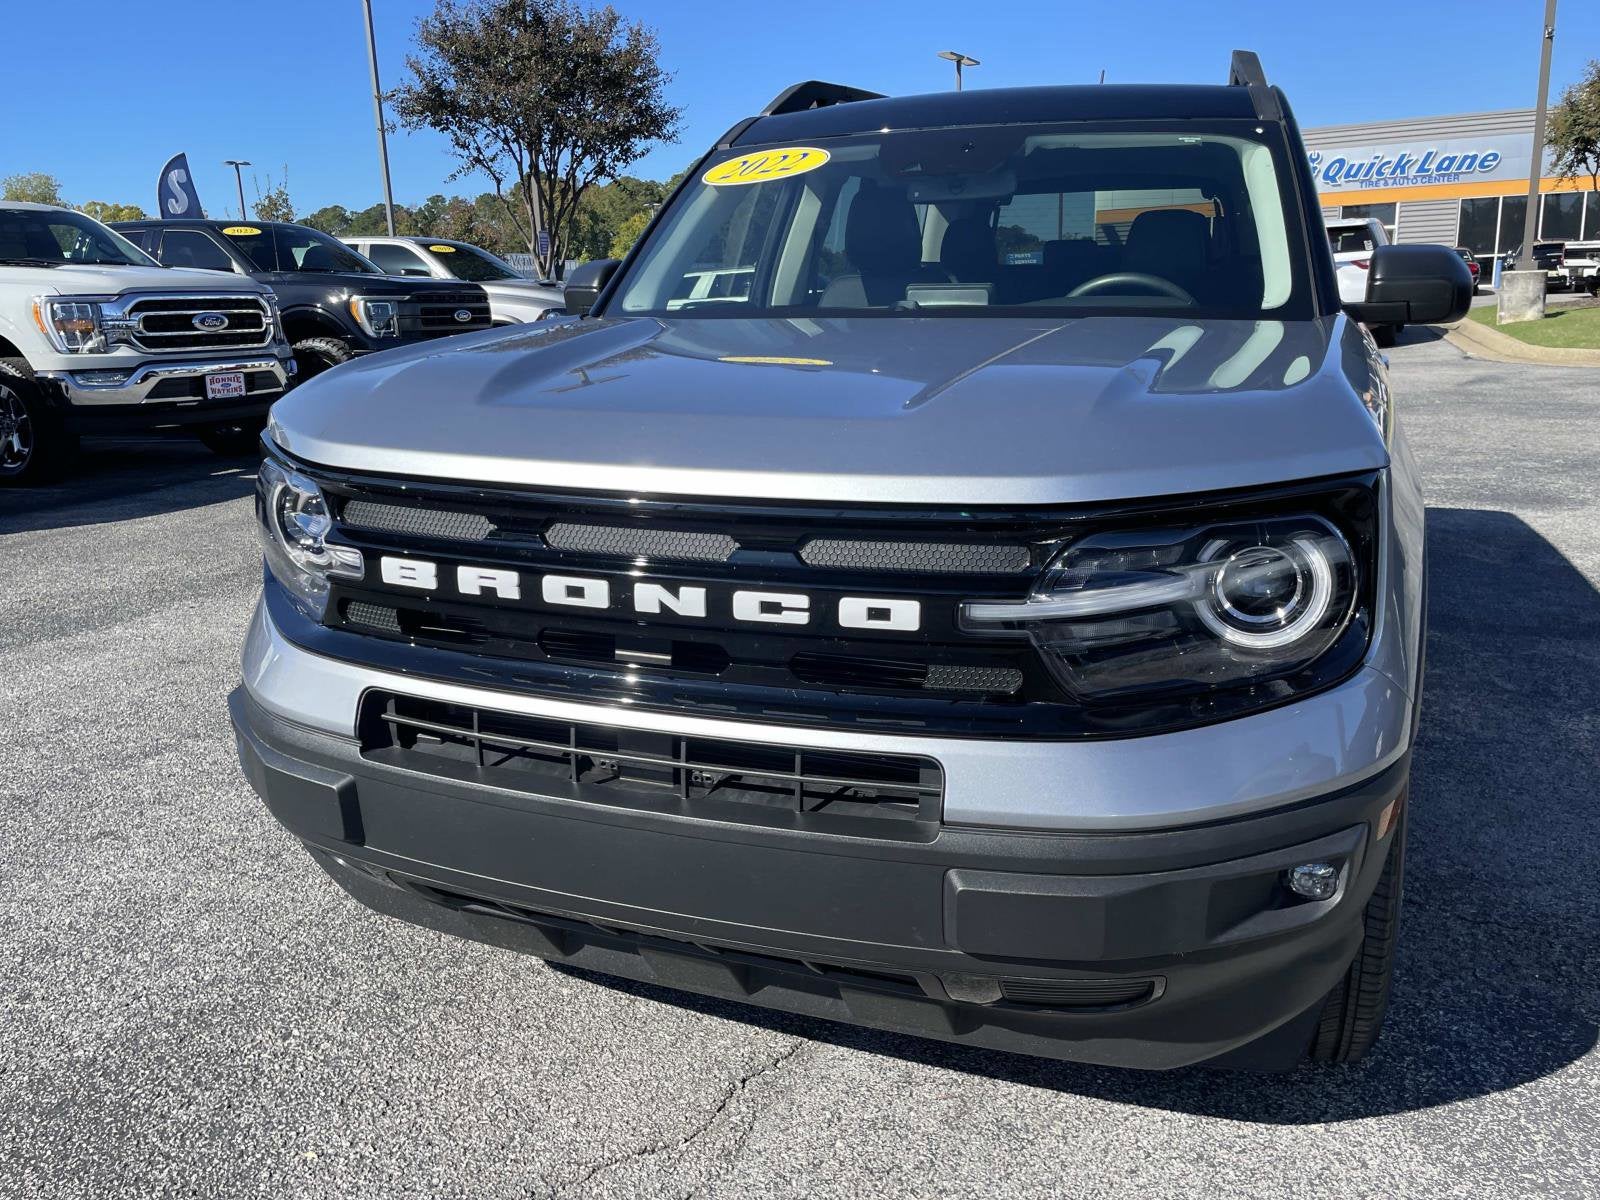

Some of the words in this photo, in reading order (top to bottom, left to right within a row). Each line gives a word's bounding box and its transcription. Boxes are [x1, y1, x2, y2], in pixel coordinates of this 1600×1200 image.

[718, 152, 809, 179] 2022
[1322, 152, 1414, 185] Quick
[1415, 150, 1501, 175] Lane
[1359, 179, 1381, 189] TIRE
[1383, 179, 1389, 187] &
[1391, 175, 1419, 187] AUTO
[1420, 173, 1460, 185] CENTER
[380, 556, 922, 631] BRONCO
